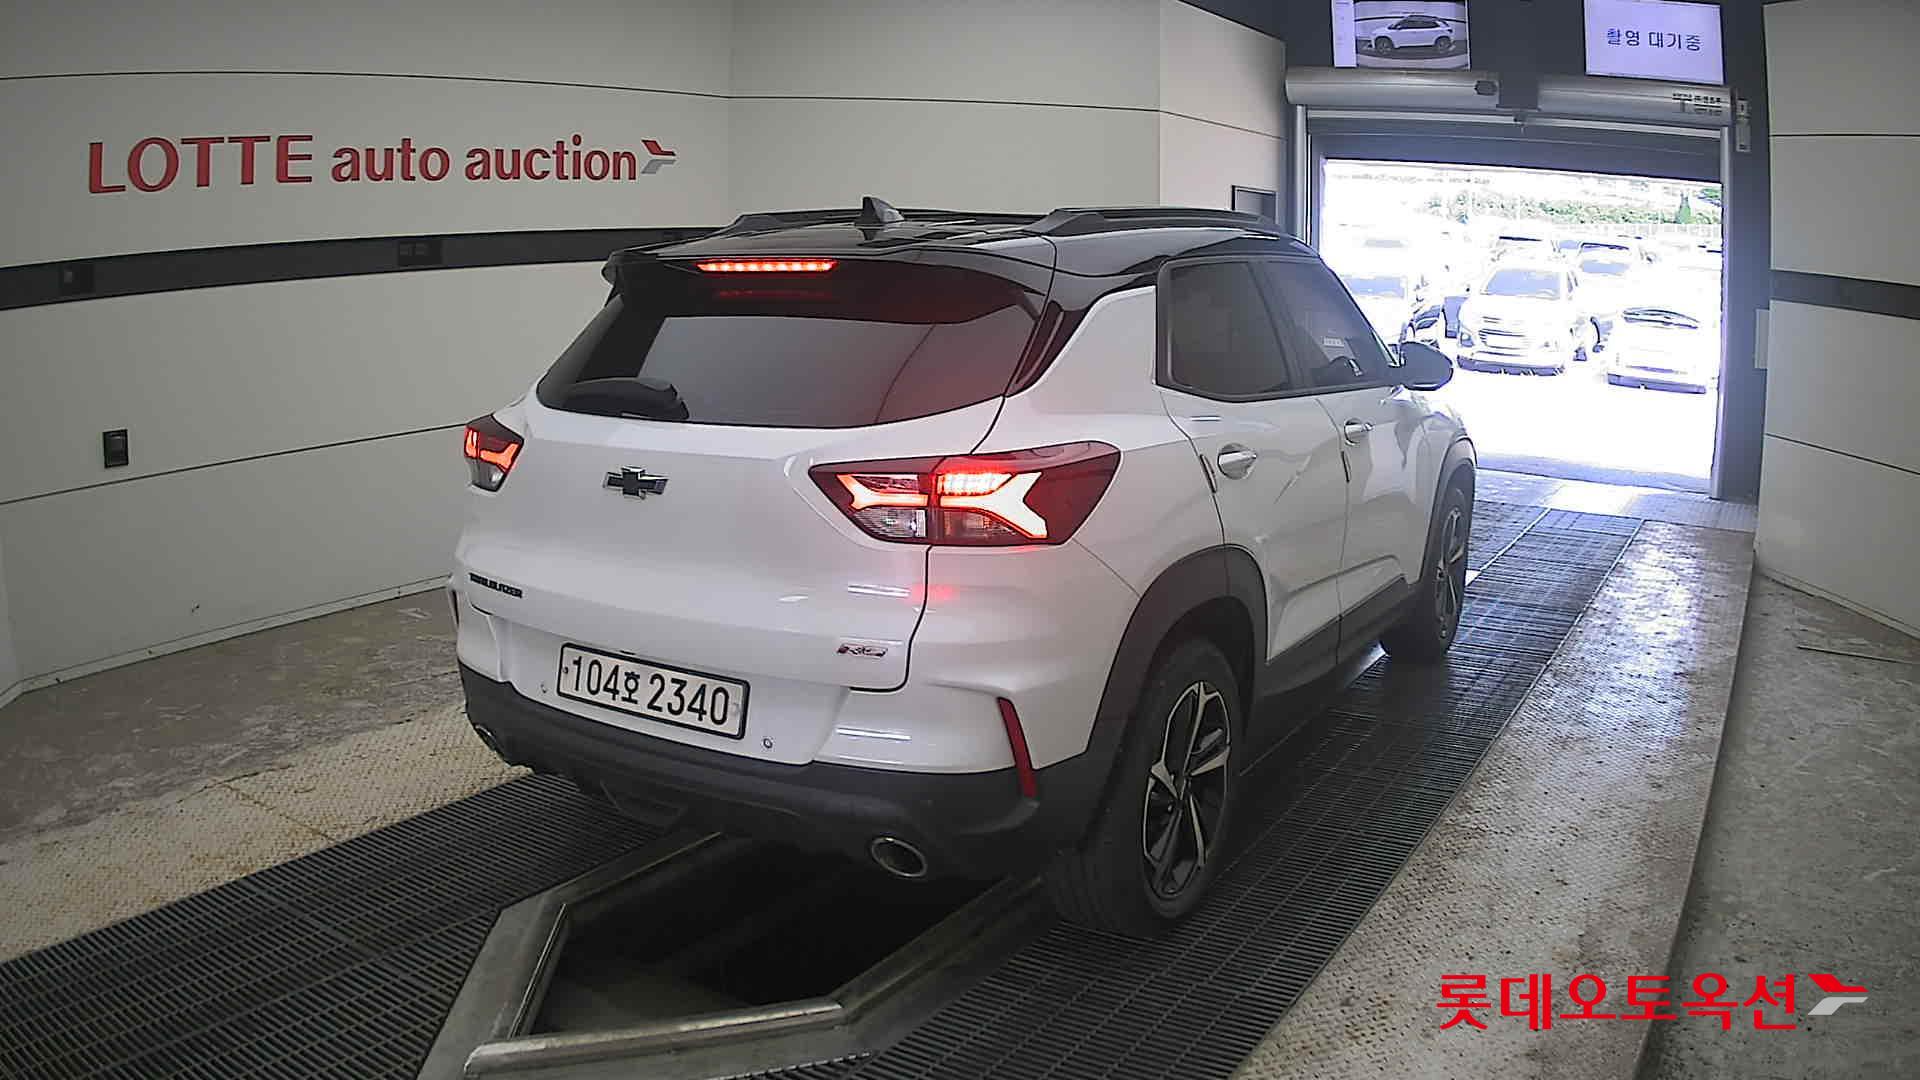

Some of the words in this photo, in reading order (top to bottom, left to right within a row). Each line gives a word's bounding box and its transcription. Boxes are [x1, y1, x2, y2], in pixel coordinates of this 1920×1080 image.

[1606, 28, 1641, 47] 촬영
[1647, 31, 1702, 52] 대기중
[88, 134, 313, 194] LOTTE
[331, 138, 452, 183] auto
[464, 134, 637, 182] auction
